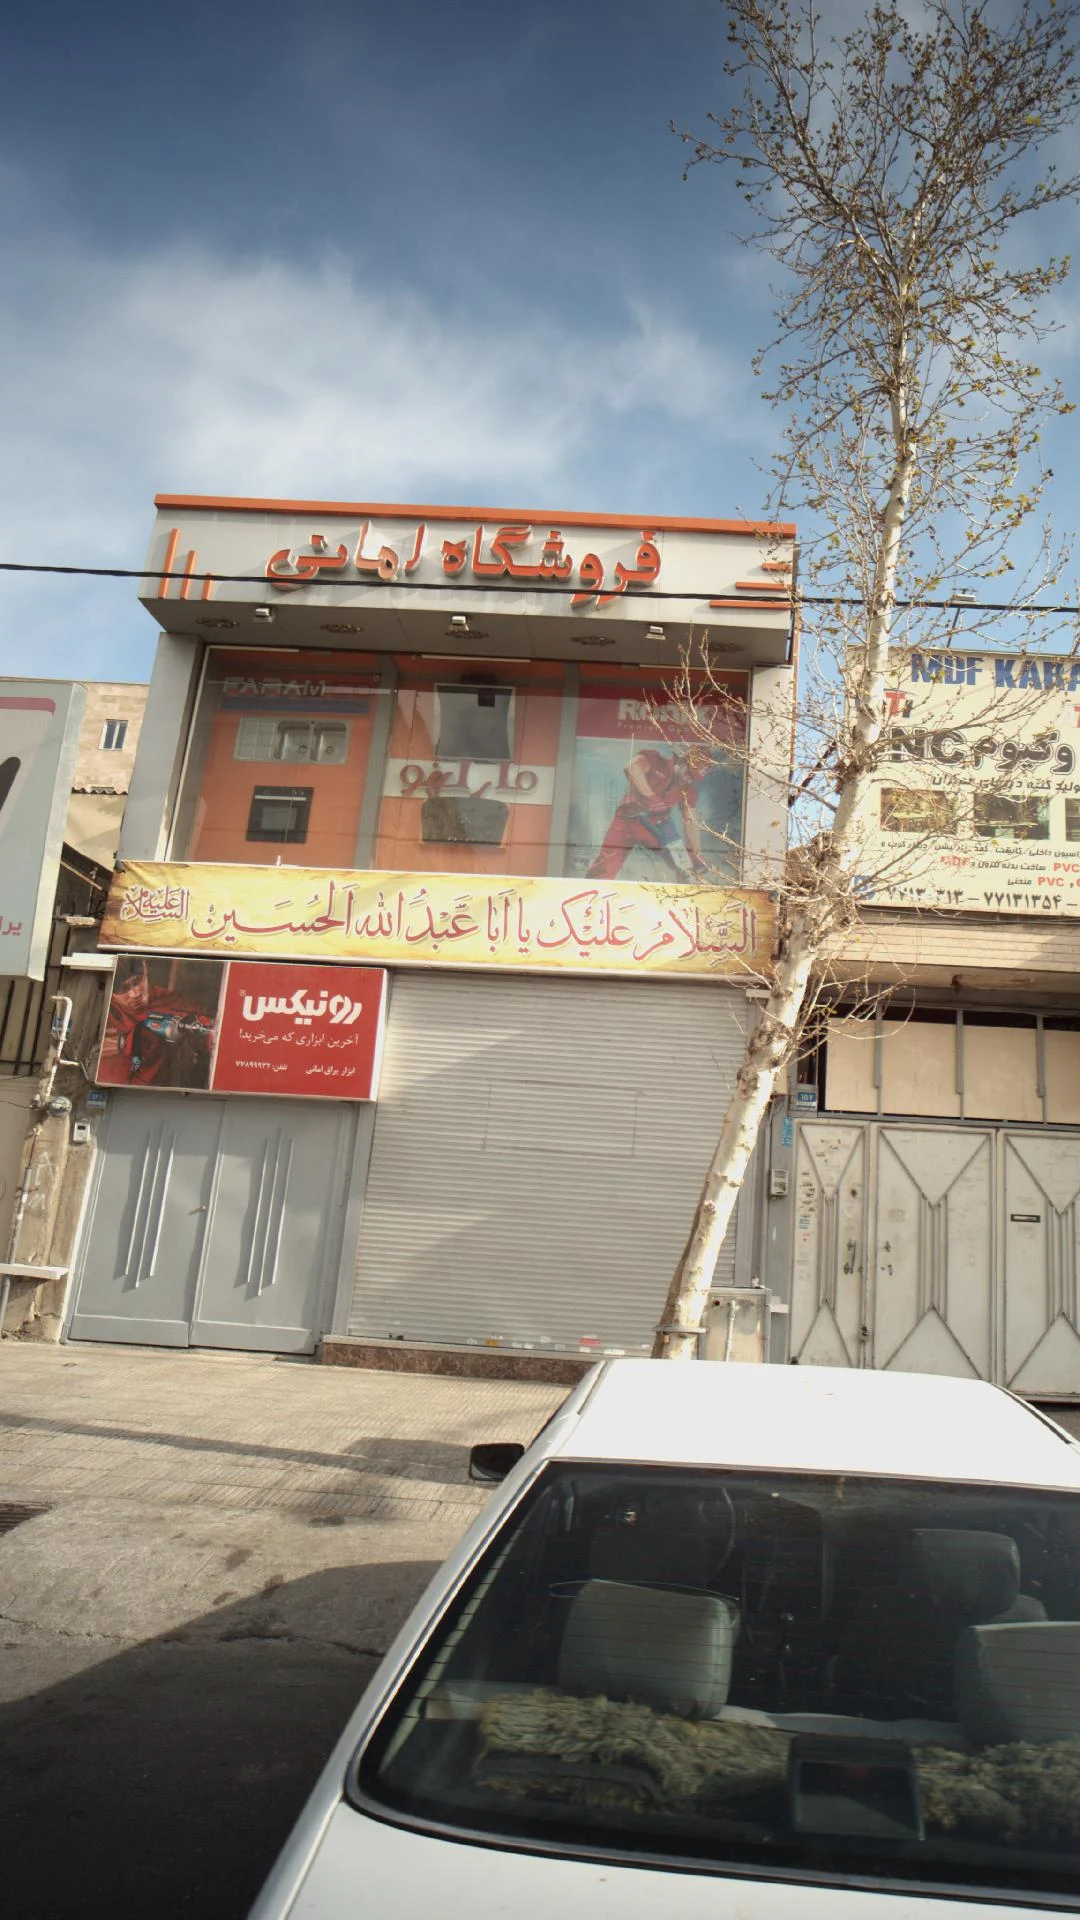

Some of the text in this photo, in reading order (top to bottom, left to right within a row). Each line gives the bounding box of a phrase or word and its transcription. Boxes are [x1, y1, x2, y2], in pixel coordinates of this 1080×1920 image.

[441, 524, 662, 609] فروشگاه
[911, 653, 983, 686] MDF
[1037, 876, 1065, 887] PVC
[983, 891, 1063, 910] ۷۷۱۳۱۳۵۴
[242, 989, 363, 1026] رونیکس
[282, 1031, 296, 1042] که
